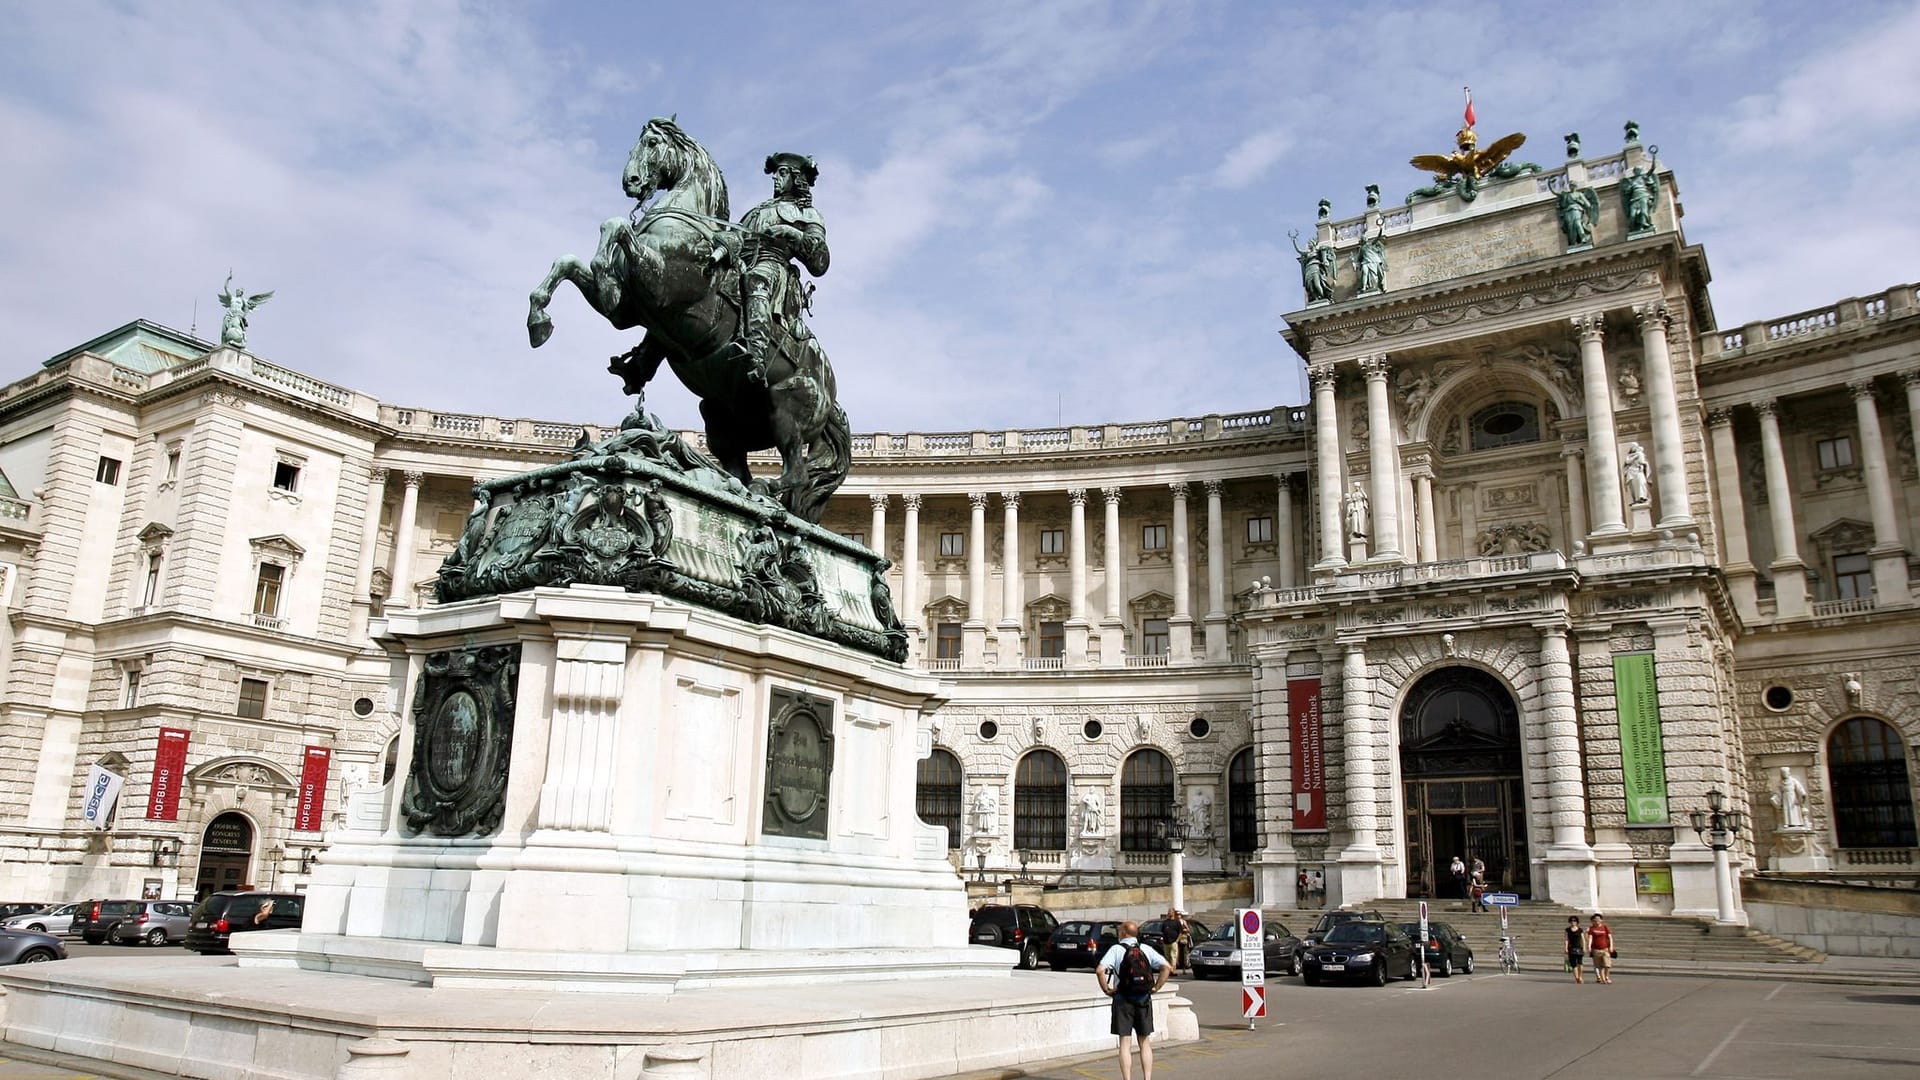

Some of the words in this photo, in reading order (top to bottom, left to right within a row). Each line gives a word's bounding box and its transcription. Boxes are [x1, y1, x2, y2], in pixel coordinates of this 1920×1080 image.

[1300, 712, 1311, 790] Österreichische
[1309, 695, 1321, 789] Nationalbibliothek
[1632, 724, 1640, 759] museum
[1640, 740, 1649, 757] und
[154, 768, 169, 819] HOFBURG
[1634, 762, 1644, 793] ephesos
[301, 783, 314, 829] HOFBURG
[1246, 934, 1258, 942] Zone
